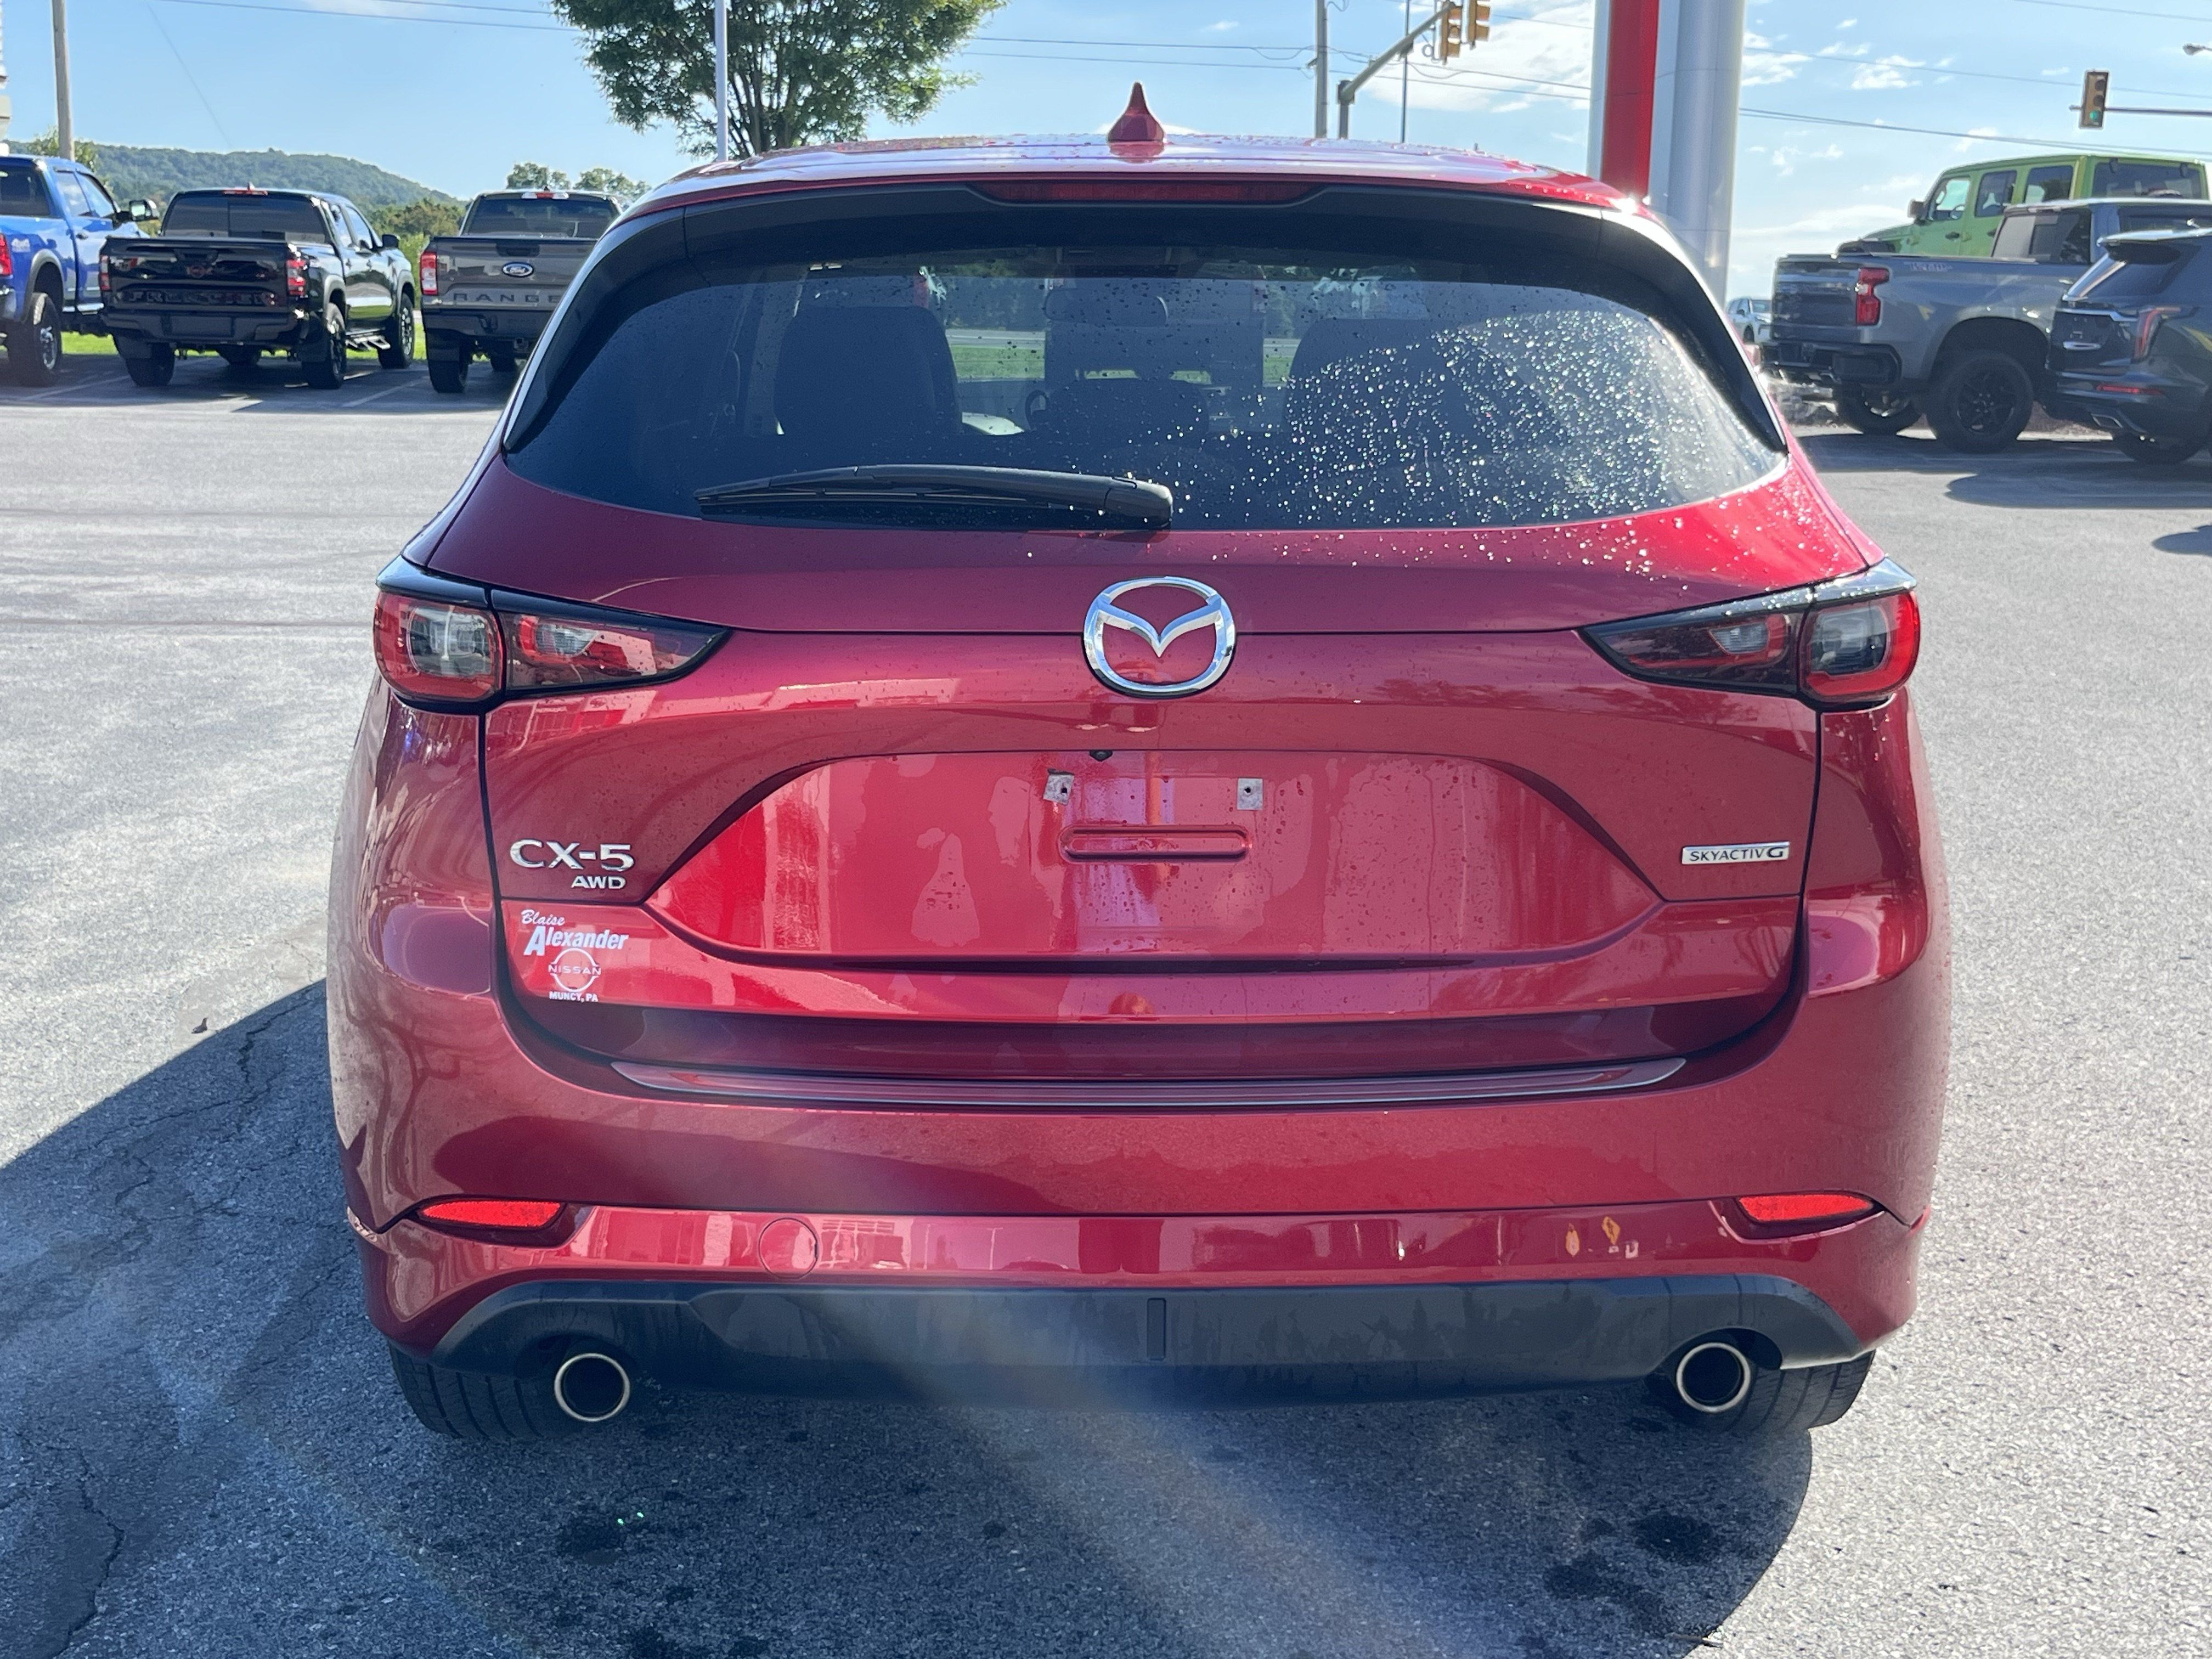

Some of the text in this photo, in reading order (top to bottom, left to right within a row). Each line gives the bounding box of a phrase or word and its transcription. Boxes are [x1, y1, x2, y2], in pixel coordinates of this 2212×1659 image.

[510, 839, 635, 872] CX-5
[571, 876, 626, 890] AWD
[521, 909, 565, 927] Blaise
[523, 926, 629, 956] Alexander
[548, 964, 601, 975] NISSAN
[549, 991, 599, 1003] MUNCY, PA
